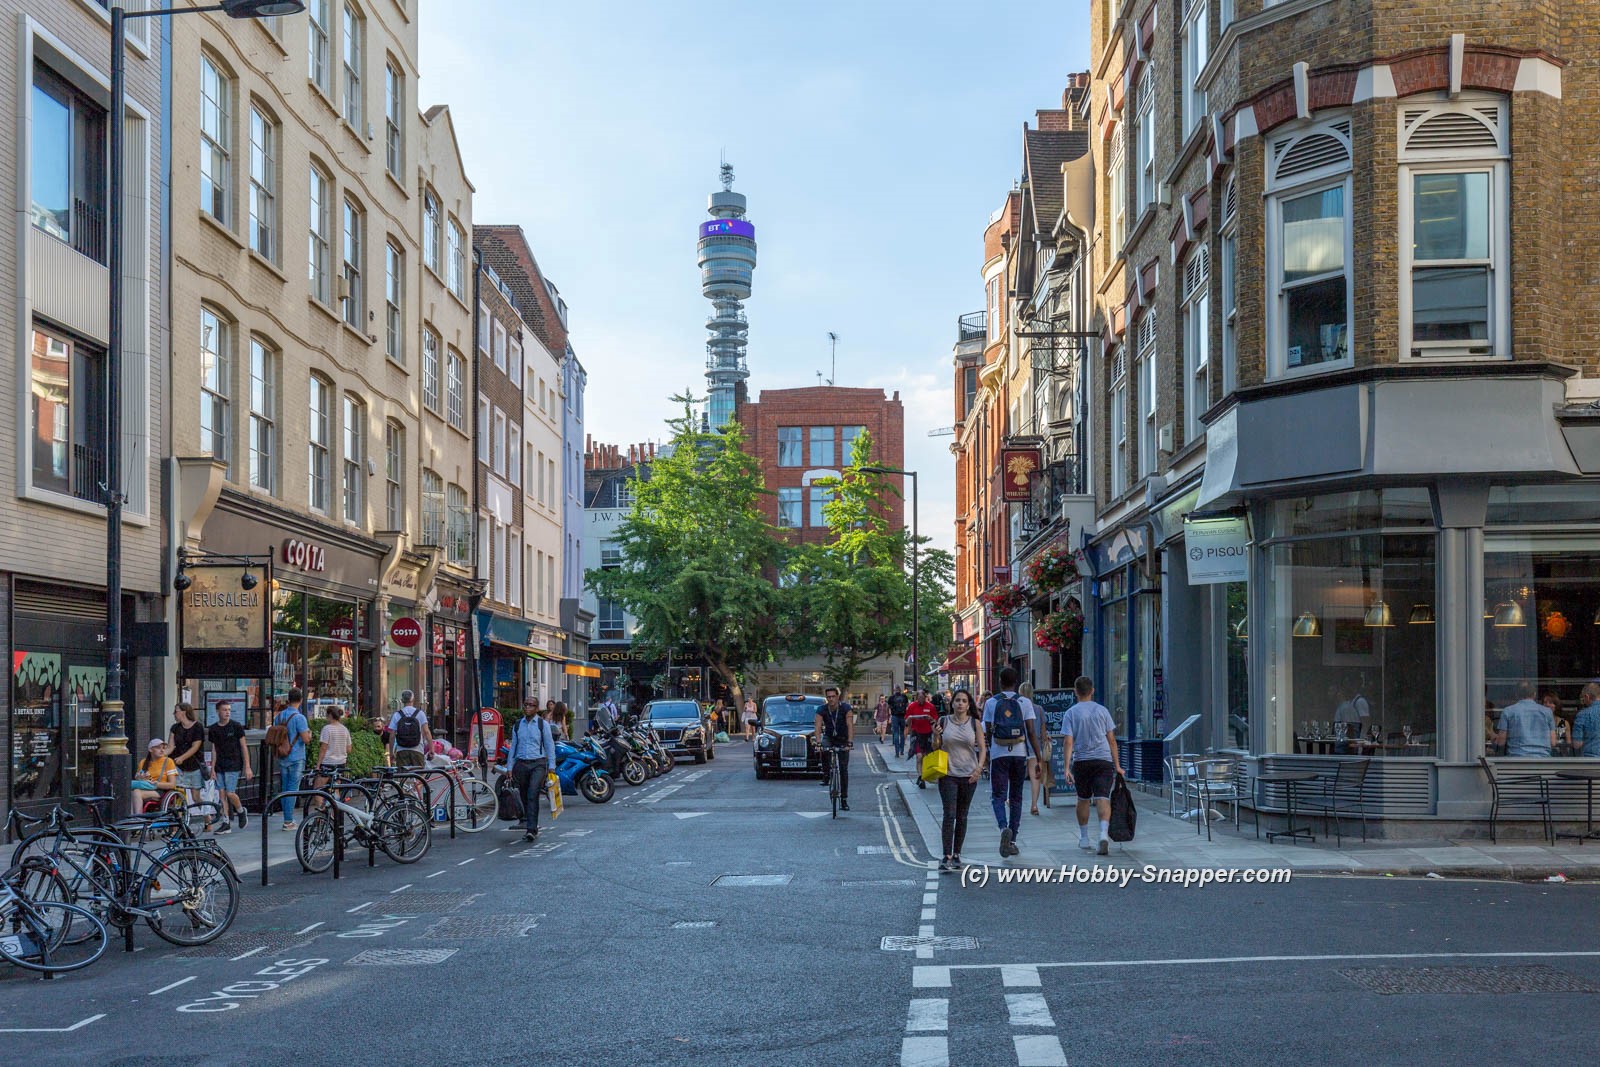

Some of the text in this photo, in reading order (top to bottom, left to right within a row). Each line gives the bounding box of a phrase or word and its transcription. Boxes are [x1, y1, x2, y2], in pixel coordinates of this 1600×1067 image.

[593, 512, 614, 523] J.W.
[287, 539, 325, 571] COSTA
[1207, 546, 1244, 558] PISQU
[189, 592, 258, 607] JERUSALEM
[393, 628, 419, 636] COSTA
[590, 653, 642, 661] ARQUIS
[436, 809, 445, 821] P
[176, 913, 419, 1013] CYCLES ONLY
